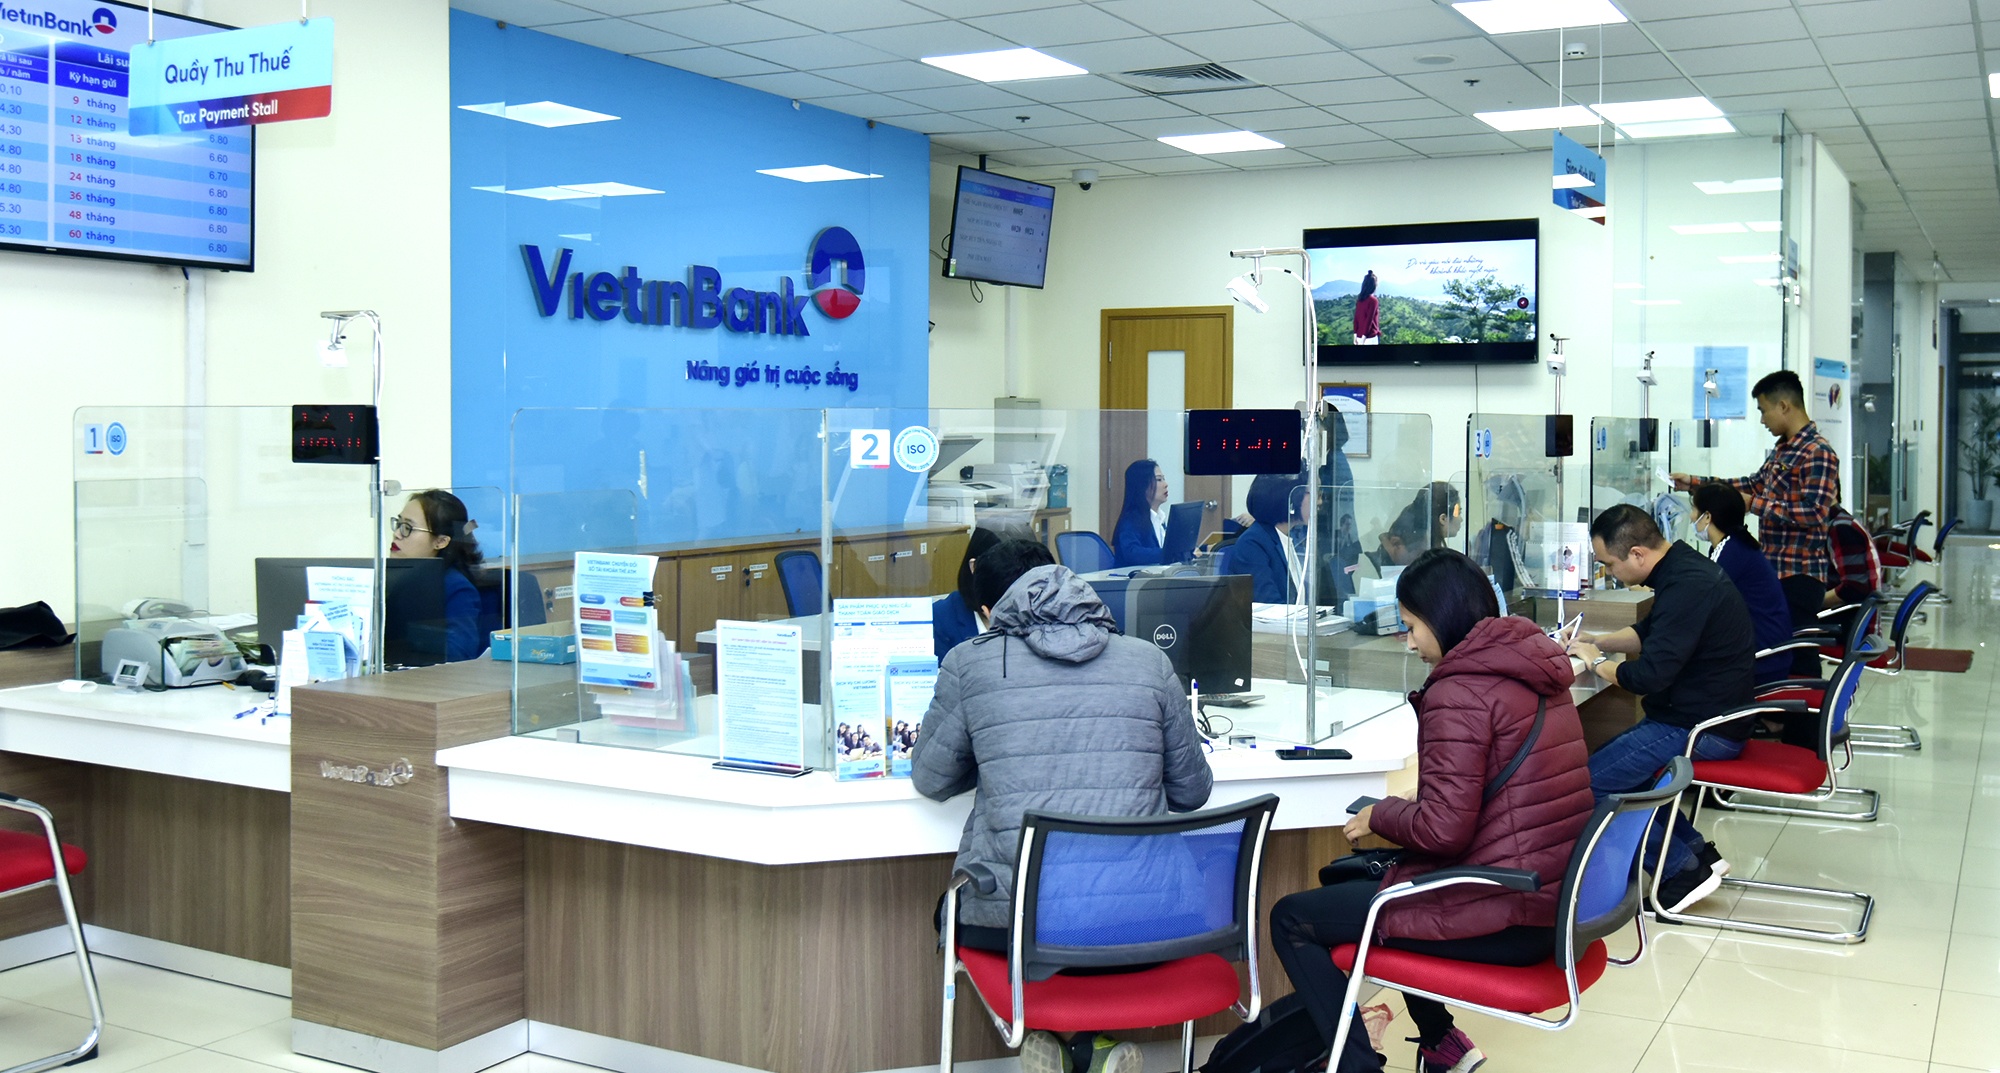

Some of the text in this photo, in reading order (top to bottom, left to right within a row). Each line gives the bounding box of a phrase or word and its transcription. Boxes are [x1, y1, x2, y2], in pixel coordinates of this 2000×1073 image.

[98, 52, 114, 65] Lãi
[165, 45, 293, 86] Quầy Thu Thuế
[69, 71, 81, 84] Kỳ
[82, 73, 100, 86] hạn
[73, 96, 116, 113] 9 tháng
[177, 99, 278, 125] Tax Payment Stall
[71, 114, 116, 132] 12 tháng
[70, 134, 116, 151] 13 tháng
[209, 134, 228, 145] 6.80
[70, 153, 116, 169] 18 tháng
[209, 153, 228, 164] 6.60
[69, 172, 116, 188] 24 tháng
[208, 170, 228, 181] 6.70
[69, 191, 116, 207] 36 tháng
[208, 188, 228, 199] 6.80
[69, 210, 116, 226] 48 tháng
[208, 205, 228, 216] 6.80
[208, 223, 228, 234] 6.80
[69, 229, 116, 245] 60 tháng
[208, 243, 227, 254] 6.80
[519, 243, 811, 337] VietinBank
[685, 359, 859, 392] Nâng giá trị cuộc sống
[90, 427, 97, 448] 1
[861, 433, 879, 460] 2
[906, 444, 926, 454] ISO
